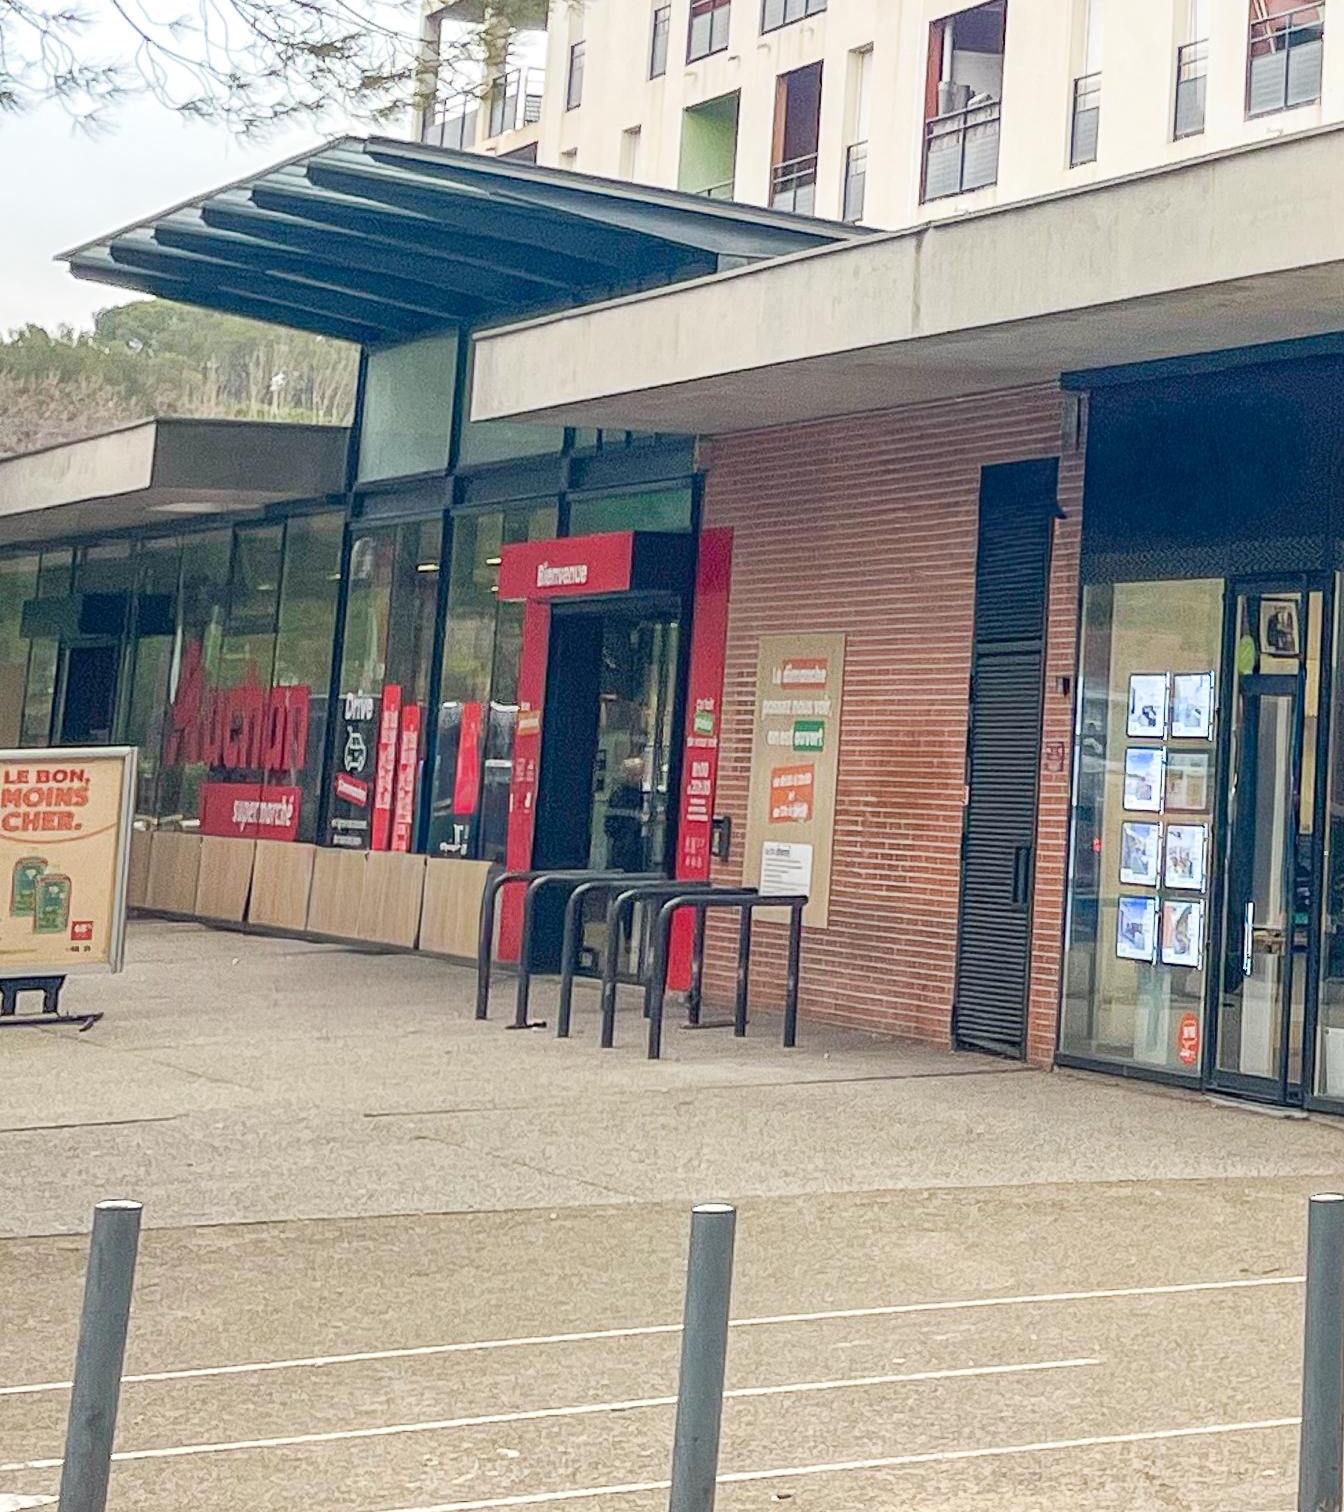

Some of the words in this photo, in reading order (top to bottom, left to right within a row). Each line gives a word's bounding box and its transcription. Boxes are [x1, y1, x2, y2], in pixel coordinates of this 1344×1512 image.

[536, 561, 588, 587] Bienvenue
[344, 688, 374, 720] Drive
[4, 770, 29, 784] LE
[36, 769, 91, 785] BON,
[0, 787, 90, 809] MOINS
[1, 810, 83, 832] CHER.
[231, 794, 295, 833] supermarché
